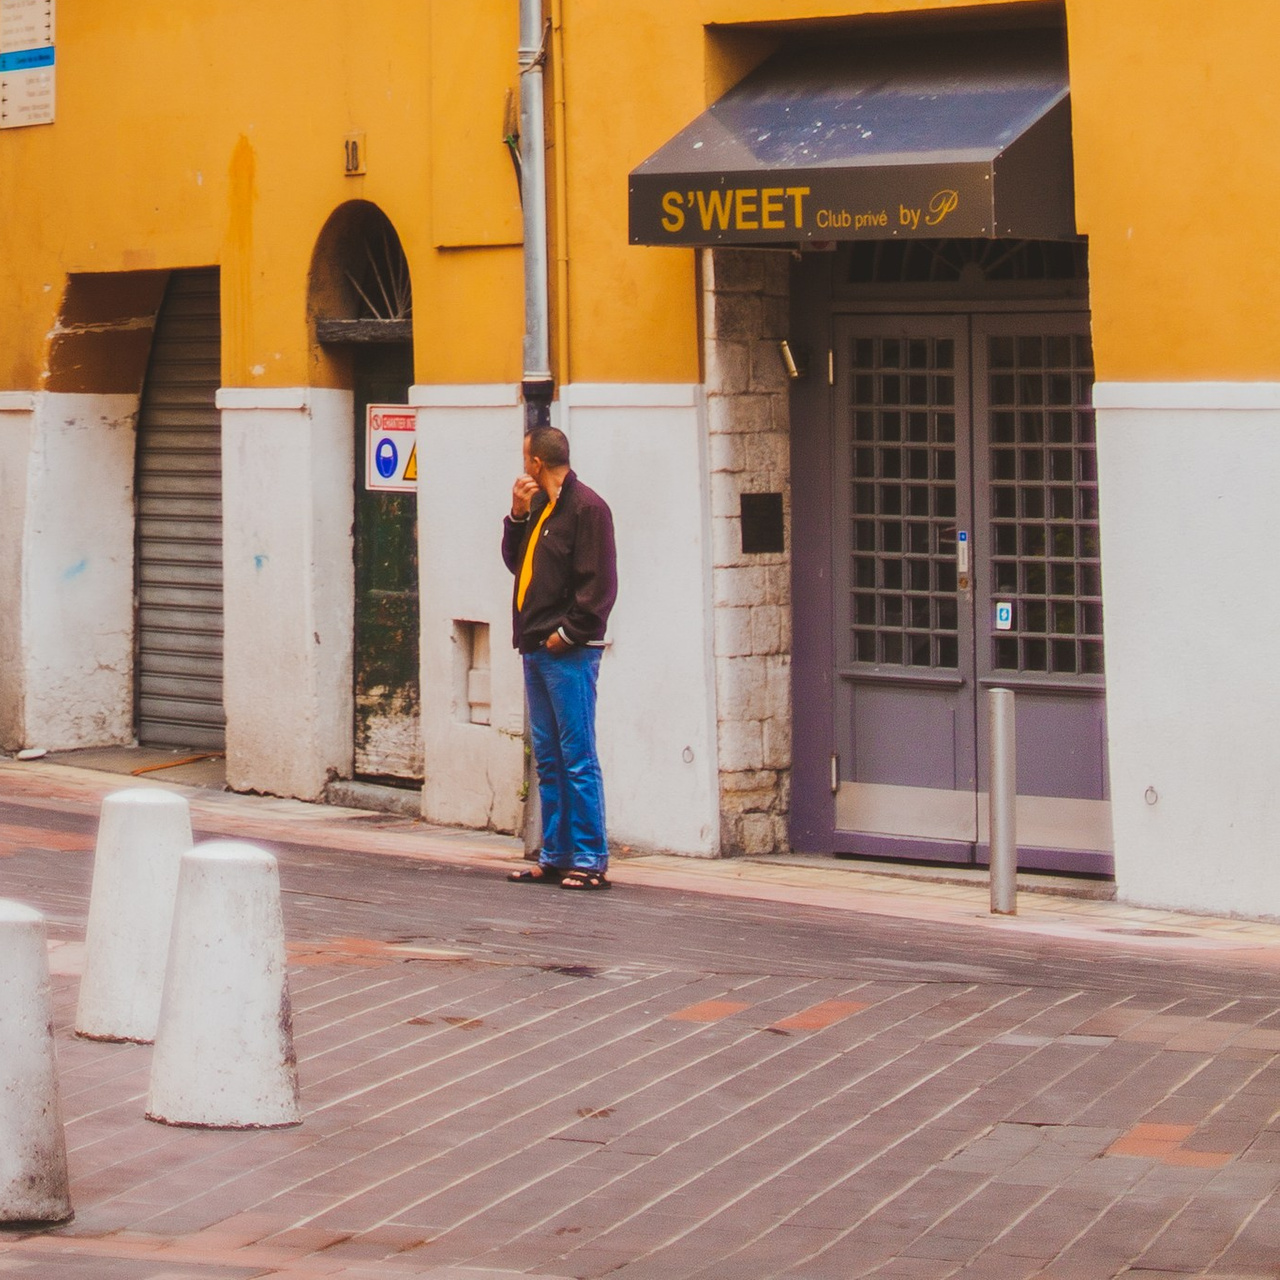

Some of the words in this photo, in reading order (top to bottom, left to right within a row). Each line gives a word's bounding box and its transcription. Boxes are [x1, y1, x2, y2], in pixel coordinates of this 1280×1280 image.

[816, 208, 852, 229] Club
[854, 209, 889, 232] privé
[900, 204, 921, 230] by
